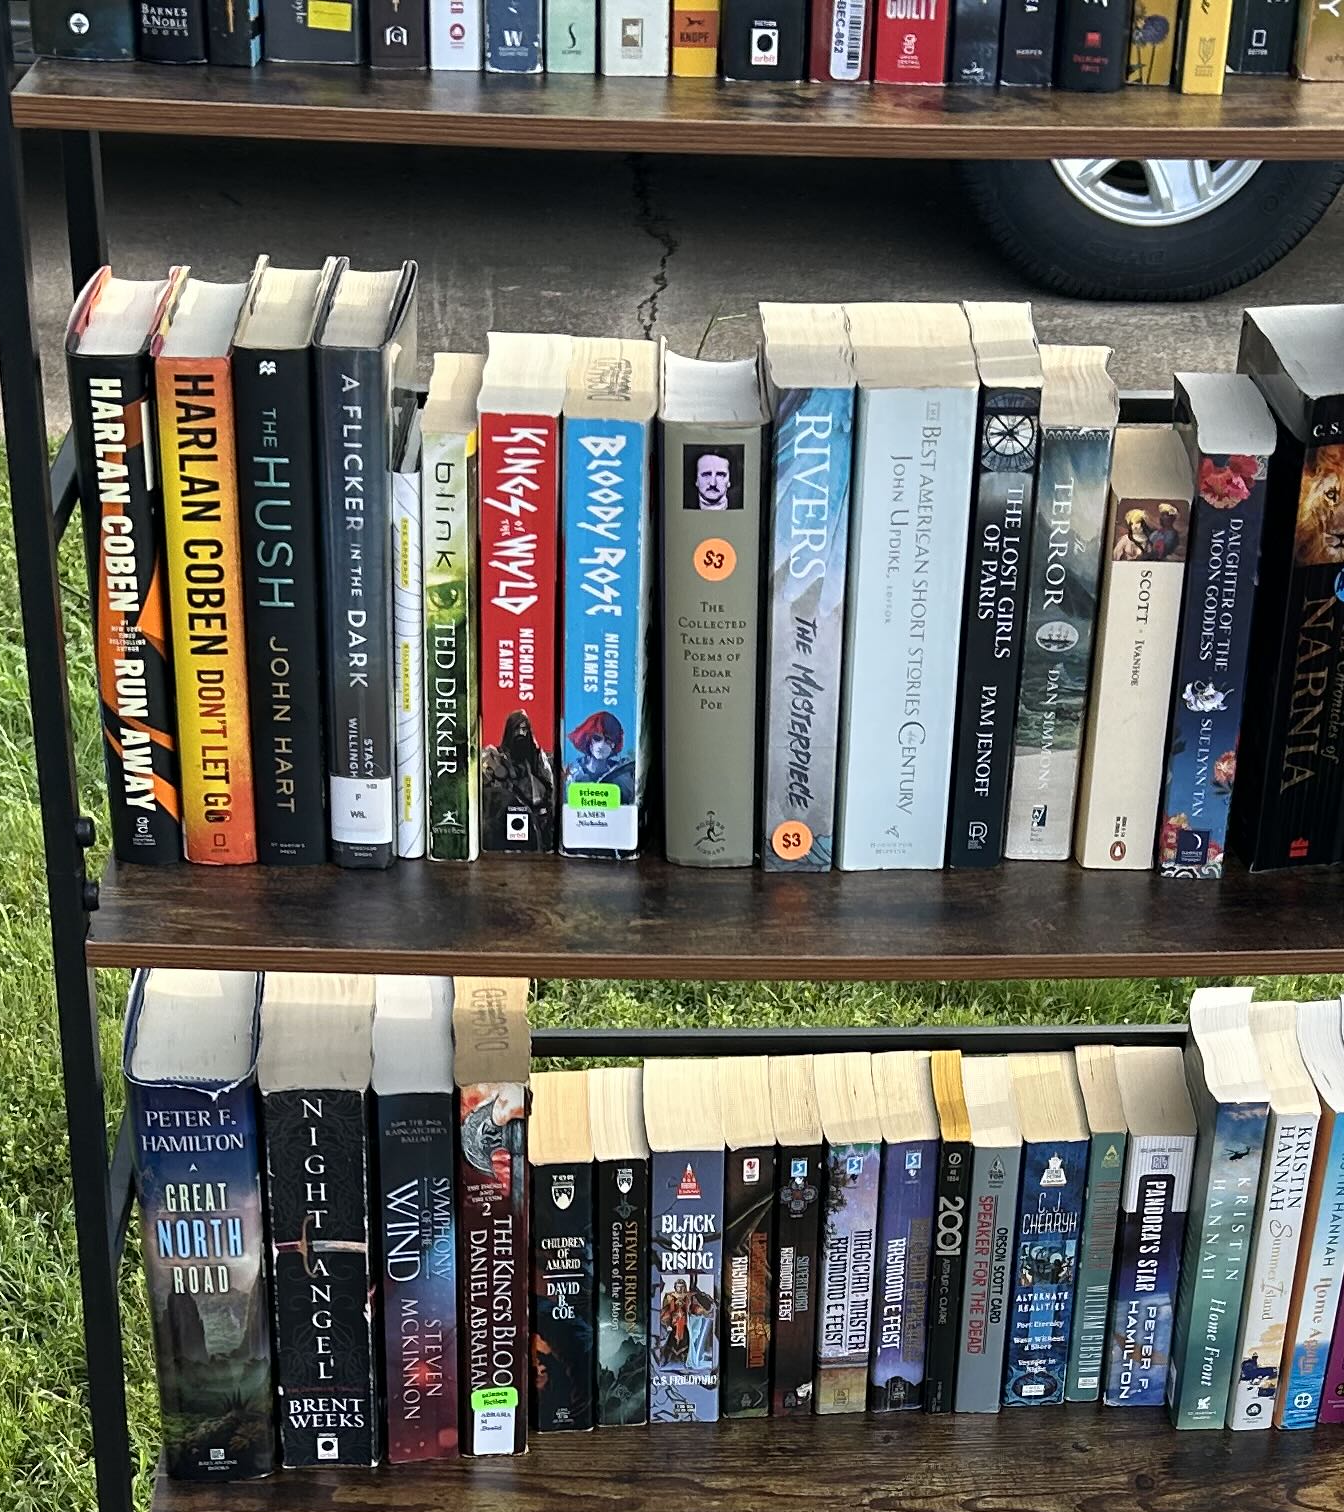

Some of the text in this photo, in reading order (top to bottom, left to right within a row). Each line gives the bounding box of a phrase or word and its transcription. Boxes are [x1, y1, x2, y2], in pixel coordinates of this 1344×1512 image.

[141, 3, 188, 17] BARNES
[679, 32, 710, 43] KNOPF
[89, 378, 131, 502] HARLAN
[1313, 423, 1325, 438] C.
[1329, 421, 1343, 436] S.
[253, 408, 295, 609] THE HUSH
[789, 411, 834, 581] RIVERS
[342, 405, 369, 689] FLICKER IN THE DARK
[577, 434, 627, 618] BLOODY ROSE
[1042, 476, 1075, 611] TERROR
[100, 515, 140, 611] COBEN
[174, 375, 230, 783] HARLAN COBEN LET
[977, 484, 1025, 660] THE LOST GIRLS PARIS
[1199, 518, 1244, 662] DAUGHTER GODDESS
[678, 616, 747, 630] COLLECTED
[700, 602, 724, 613] THE
[1137, 569, 1153, 625] SCOTT
[498, 627, 535, 702] NICHOLAS EAMES
[680, 634, 745, 646] TALES AND
[684, 650, 741, 662] POEMS OF
[113, 659, 149, 718] RUN
[584, 633, 619, 707] NICHOLAS EAMES
[692, 667, 732, 679] EDGAR
[692, 683, 730, 695] ALLAN
[1279, 595, 1338, 796] NARNIA
[269, 636, 295, 814] JOHN HART
[433, 621, 457, 778] TED DEKKER
[700, 699, 723, 710] POE
[979, 685, 998, 727] PAM
[119, 728, 156, 811] AWAY
[363, 737, 374, 778] STACY
[141, 1132, 244, 1153] HAMILTON
[145, 1109, 211, 1129] PETER
[165, 1182, 227, 1212] GREAT
[1269, 1126, 1314, 1212] KRISTIN HANNAH
[157, 1217, 244, 1259] NORTH
[386, 1177, 453, 1282] SYMPHONY WIND
[482, 1202, 513, 1256] 2 THE
[541, 1237, 585, 1250] CHILDREN
[624, 1220, 638, 1273] STEVEN
[661, 1214, 715, 1233] BLACK
[936, 1196, 965, 1256] 2001
[1135, 1180, 1168, 1293] PANDORA'S STAR
[1201, 1177, 1252, 1281] KRISTIN HANNAH
[172, 1265, 230, 1294] ROAD
[470, 1229, 488, 1302] DANIEL
[545, 1258, 581, 1271] AMARID
[557, 1249, 570, 1259] OF
[661, 1251, 714, 1270] RISING
[826, 1236, 849, 1301] RAYMOND
[967, 1194, 994, 1356] SPEAKER FOR THE DEAD
[989, 1227, 1008, 1325] ORSON SCOTT CARD
[547, 1282, 580, 1296] DAVID
[552, 1306, 575, 1320] COE
[423, 1319, 443, 1398] STEVEN
[1119, 1300, 1158, 1400] PETER HAMILTON
[289, 1398, 362, 1414] BRENT
[289, 1413, 365, 1429] WEEKS
